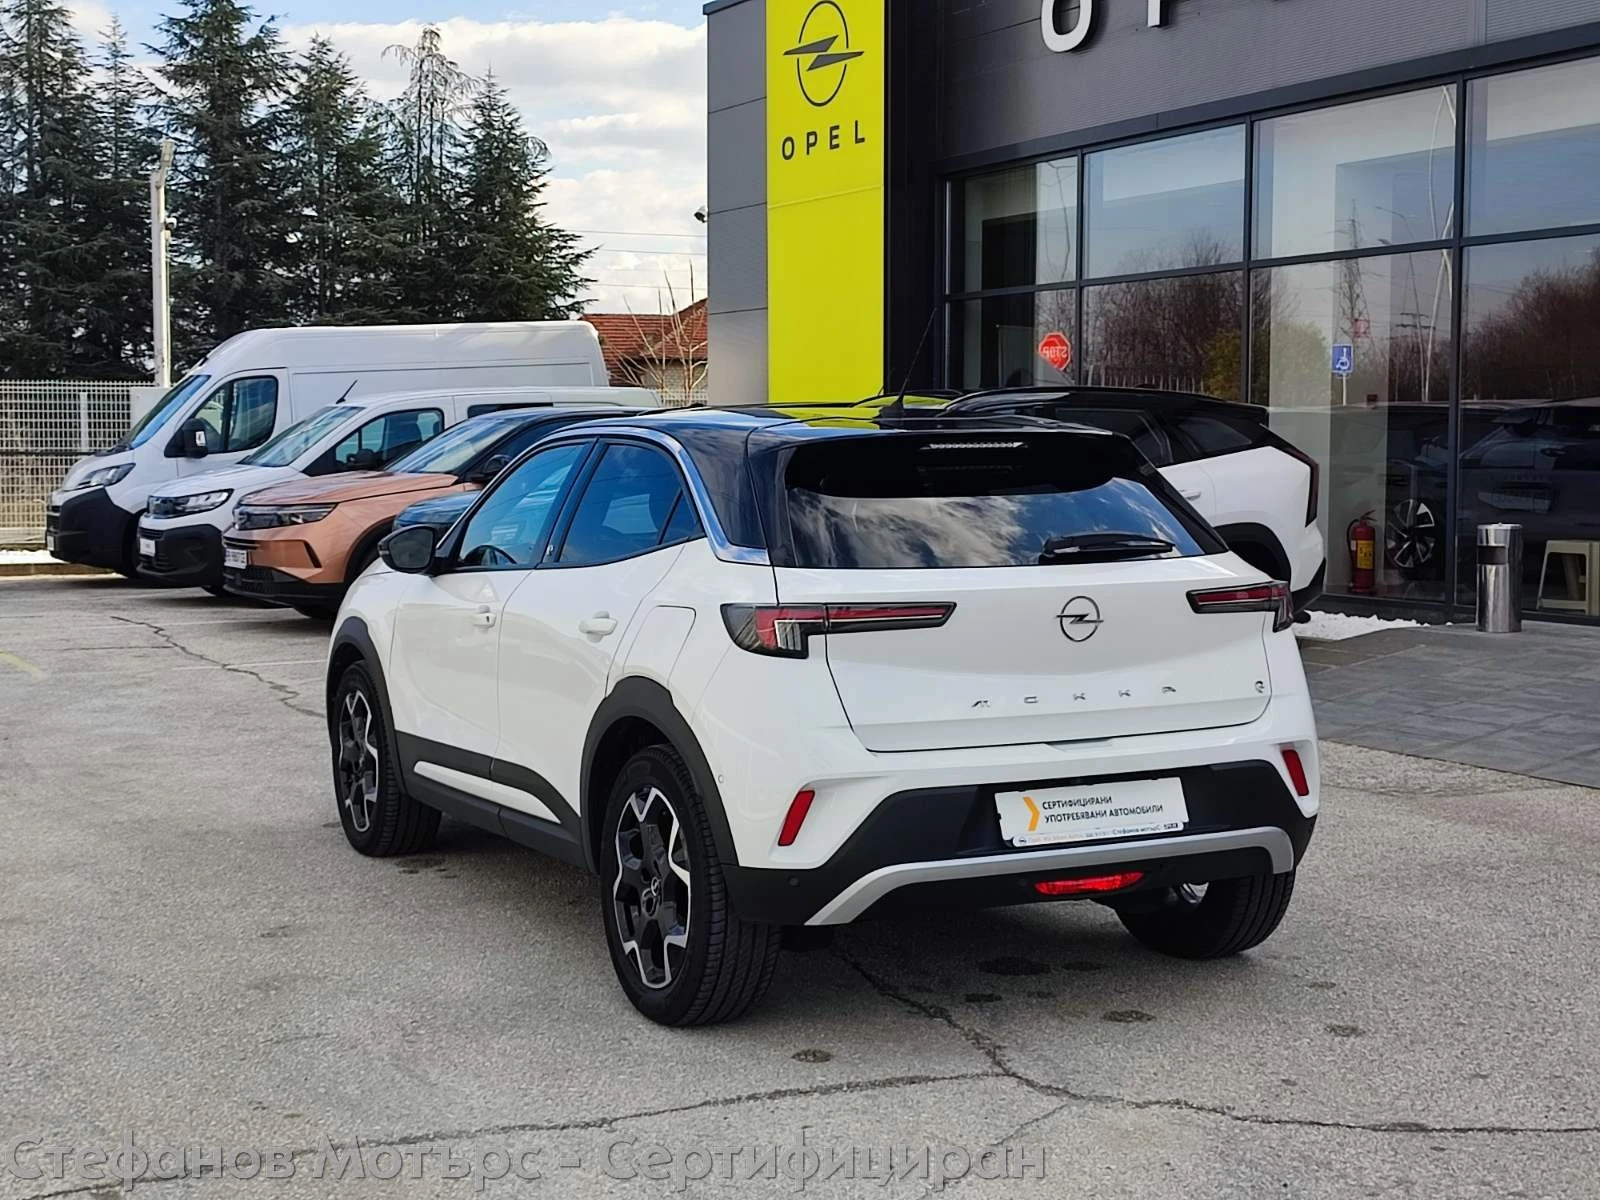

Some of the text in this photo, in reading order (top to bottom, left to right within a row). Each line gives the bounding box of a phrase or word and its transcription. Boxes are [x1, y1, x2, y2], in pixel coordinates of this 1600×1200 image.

[782, 120, 865, 160] OPEL
[1042, 796, 1113, 810] СЕРТИФИЦИРАНИ
[1044, 804, 1164, 824] УПОТРЕБЯВАНИ АВТОМОБИЛИ
